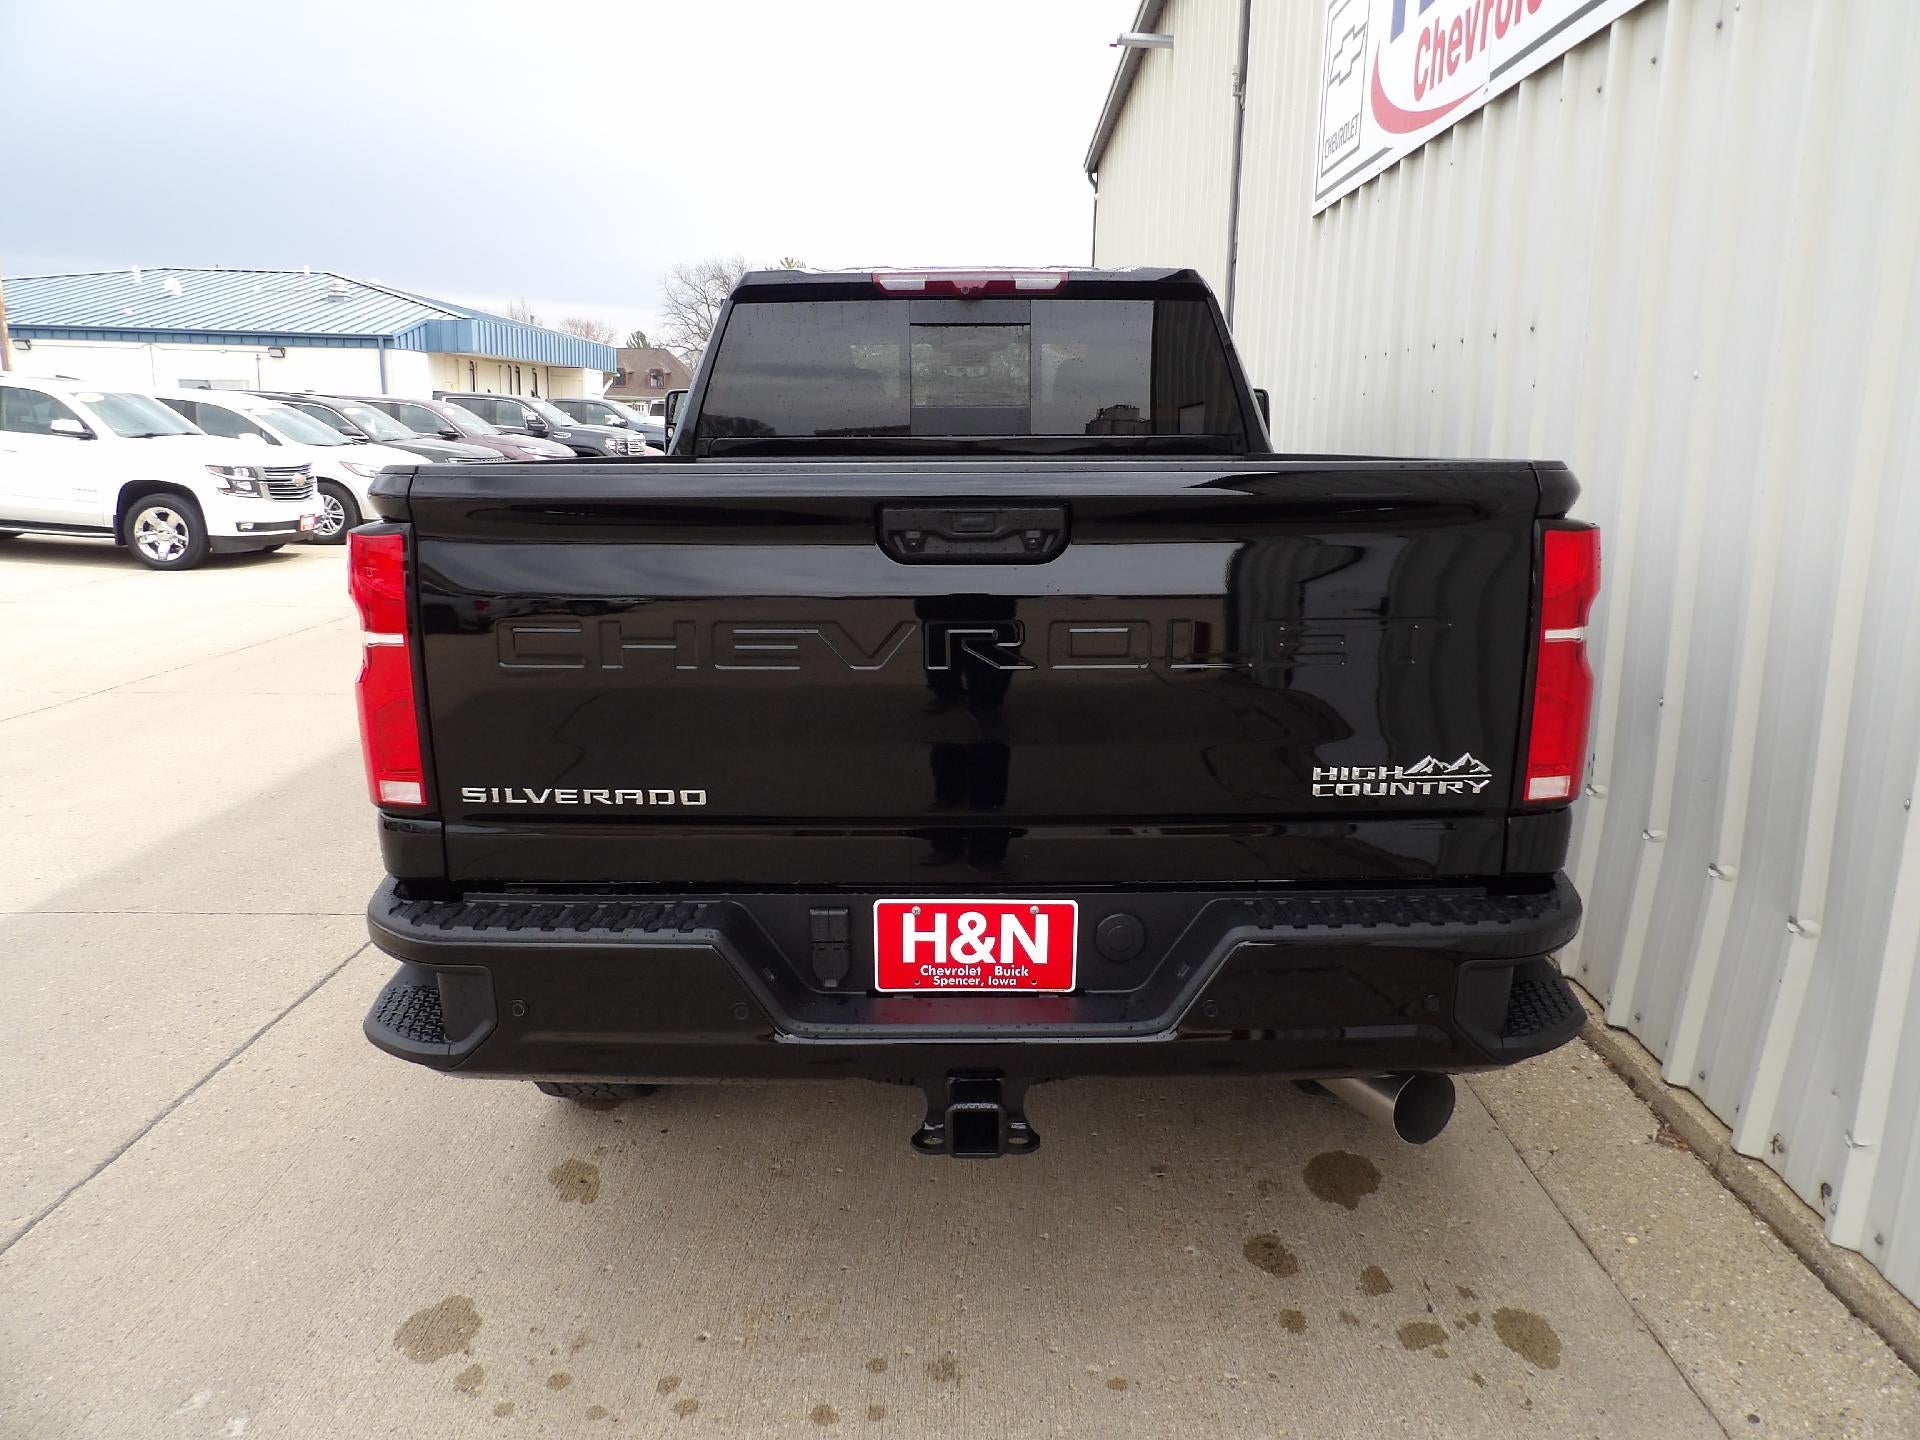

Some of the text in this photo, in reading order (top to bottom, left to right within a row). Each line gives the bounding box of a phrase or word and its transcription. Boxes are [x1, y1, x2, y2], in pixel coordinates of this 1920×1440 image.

[1413, 0, 1542, 101] Chevro
[1324, 112, 1359, 159] CHEVROLET
[1312, 766, 1404, 781] HIGH
[461, 787, 707, 806] SILVERADO
[1312, 780, 1491, 797] COUNTRY
[902, 911, 1049, 964] H&N
[920, 965, 1029, 977] Chevrolet Buick
[933, 976, 1017, 987] Spencer, Iowa
